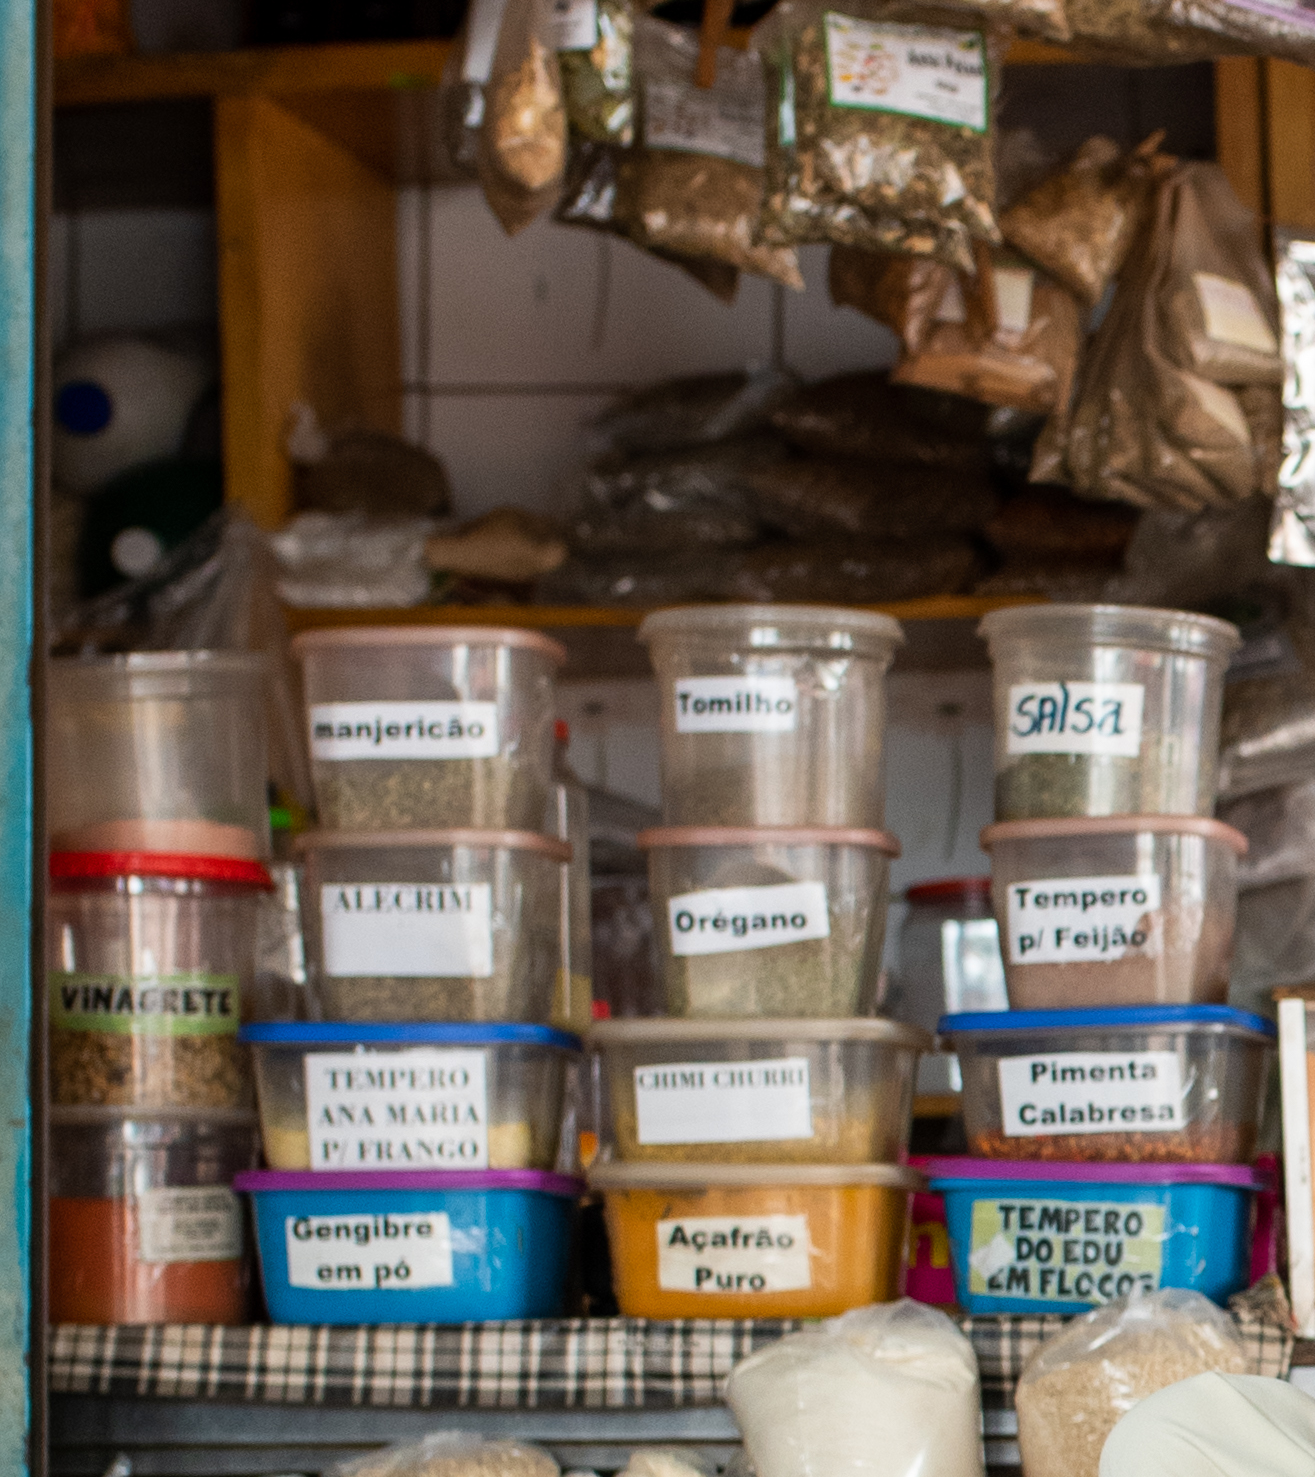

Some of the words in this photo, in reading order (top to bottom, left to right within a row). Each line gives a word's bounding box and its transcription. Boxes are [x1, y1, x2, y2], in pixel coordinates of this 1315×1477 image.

[677, 691, 795, 718] Tomilho
[313, 716, 485, 745] manjericão
[336, 889, 473, 913] ALECRIM
[1014, 887, 1148, 911] Tempero
[675, 904, 808, 939] Orégano
[1018, 928, 1044, 954] p/
[1054, 925, 1148, 953] Feijão
[60, 984, 232, 1016] VINAGRETE
[325, 1068, 470, 1091] TEMPERO
[638, 1070, 705, 1089] CHIMI
[713, 1068, 805, 1088] CHURRI
[1031, 1060, 1158, 1083] Pimenta
[320, 1104, 375, 1126] ANA
[386, 1102, 480, 1125] MARIA
[1019, 1102, 1175, 1126] Calabresa
[321, 1139, 349, 1165] P/
[357, 1138, 480, 1162] FRANGO
[292, 1215, 434, 1246] Gengibre
[998, 1204, 1144, 1236] TEMPERO
[668, 1224, 795, 1252] Açafrão
[1016, 1236, 1054, 1263] DO
[1063, 1239, 1123, 1266] EDU
[316, 1262, 362, 1281] em
[374, 1258, 412, 1289] pó
[694, 1266, 766, 1291] Puro
